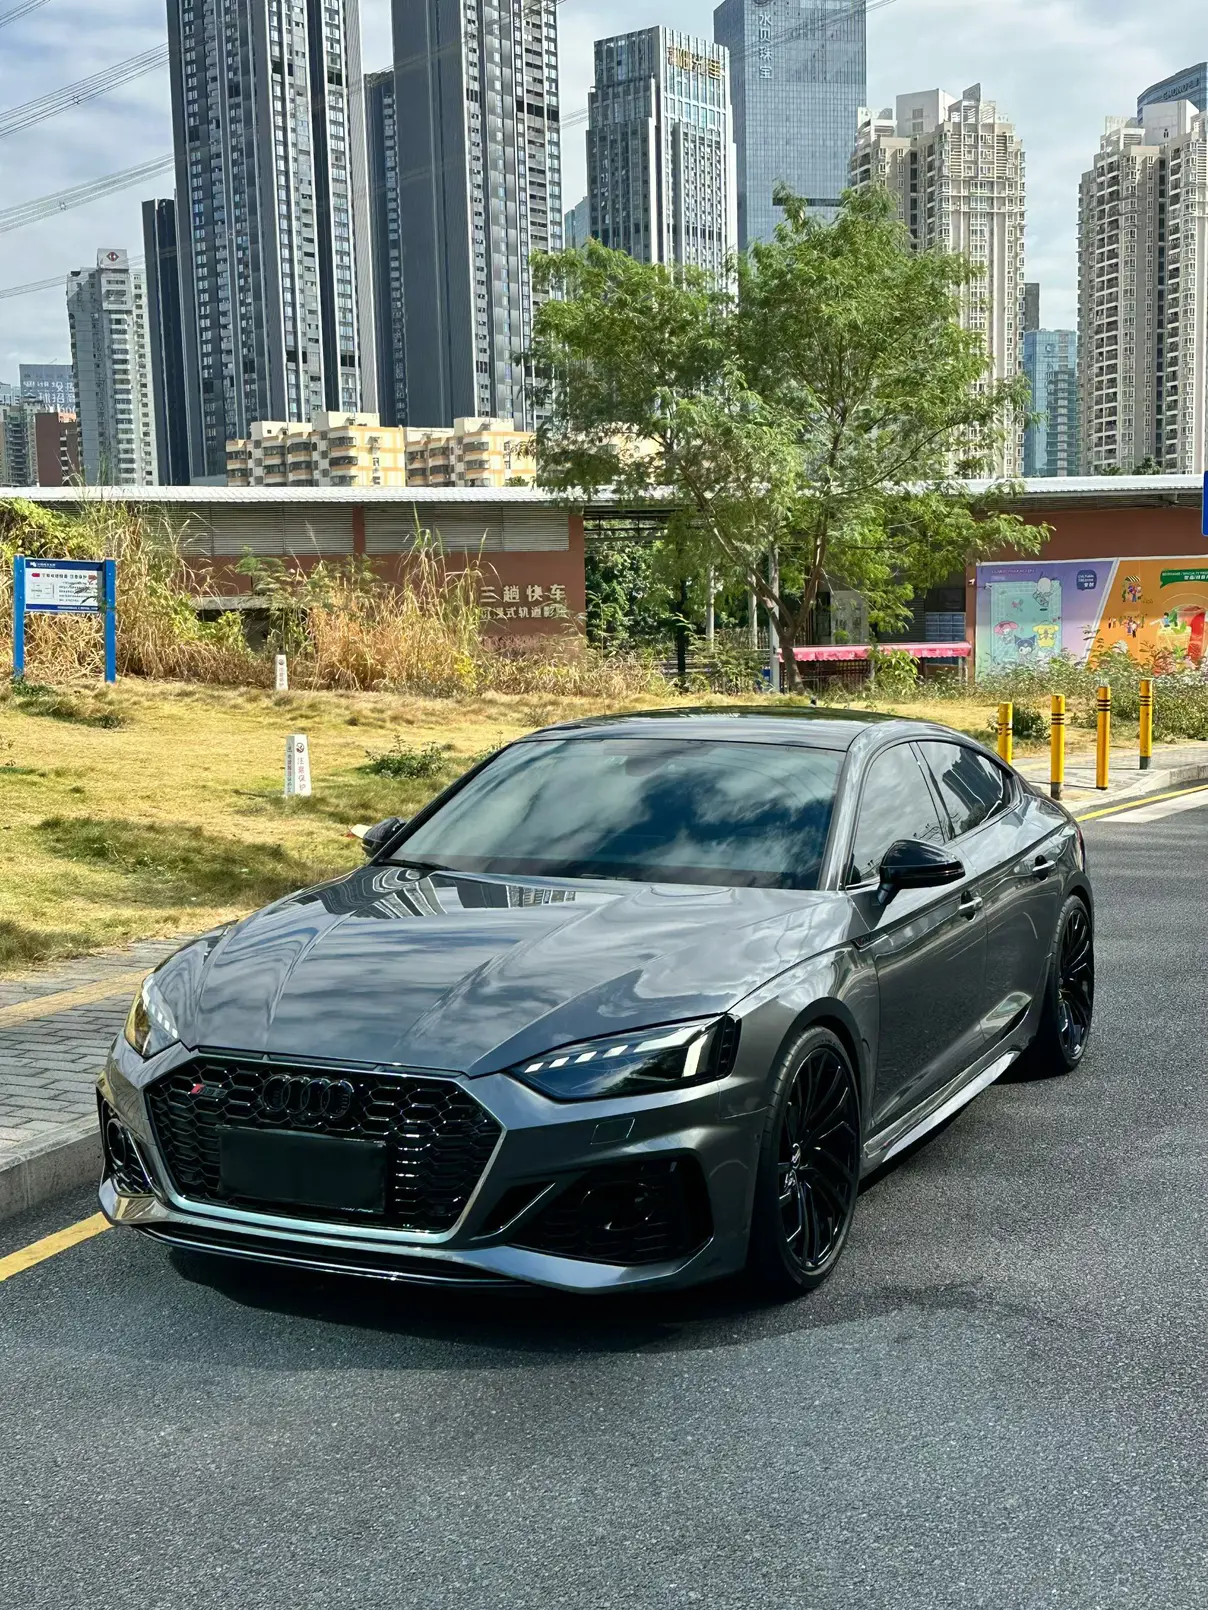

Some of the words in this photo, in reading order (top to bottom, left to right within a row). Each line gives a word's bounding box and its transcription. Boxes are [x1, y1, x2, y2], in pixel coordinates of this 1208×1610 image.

[759, 11, 772, 79] 水贝珠宝
[480, 584, 566, 603] 三趟快车
